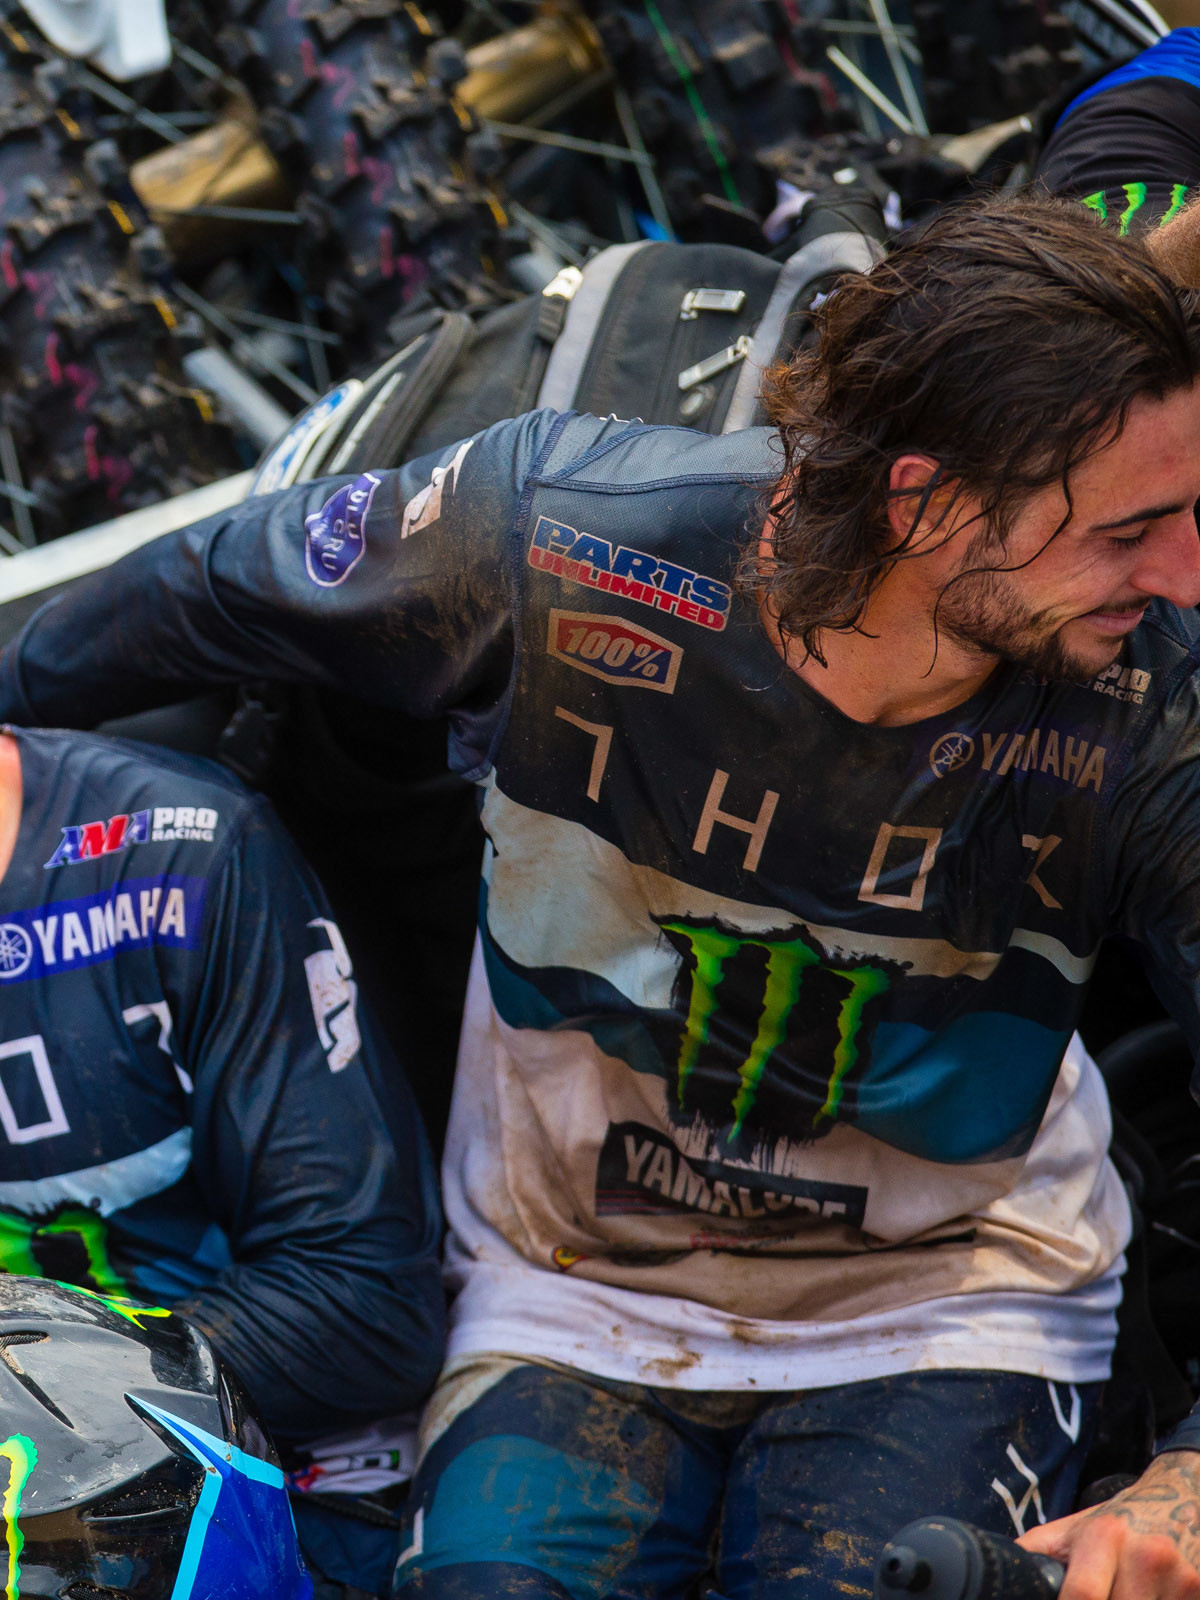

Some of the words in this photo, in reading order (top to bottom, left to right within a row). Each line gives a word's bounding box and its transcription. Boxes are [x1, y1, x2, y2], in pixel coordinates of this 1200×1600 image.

[528, 545, 728, 631] UNLIMITED
[531, 516, 732, 612] PARTS
[564, 625, 660, 679] 100%
[980, 727, 1107, 793] YAMAHA
[43, 808, 152, 870] AMA
[151, 827, 214, 842] RACING
[152, 806, 218, 830] PRO
[32, 886, 187, 966] YAMAHA
